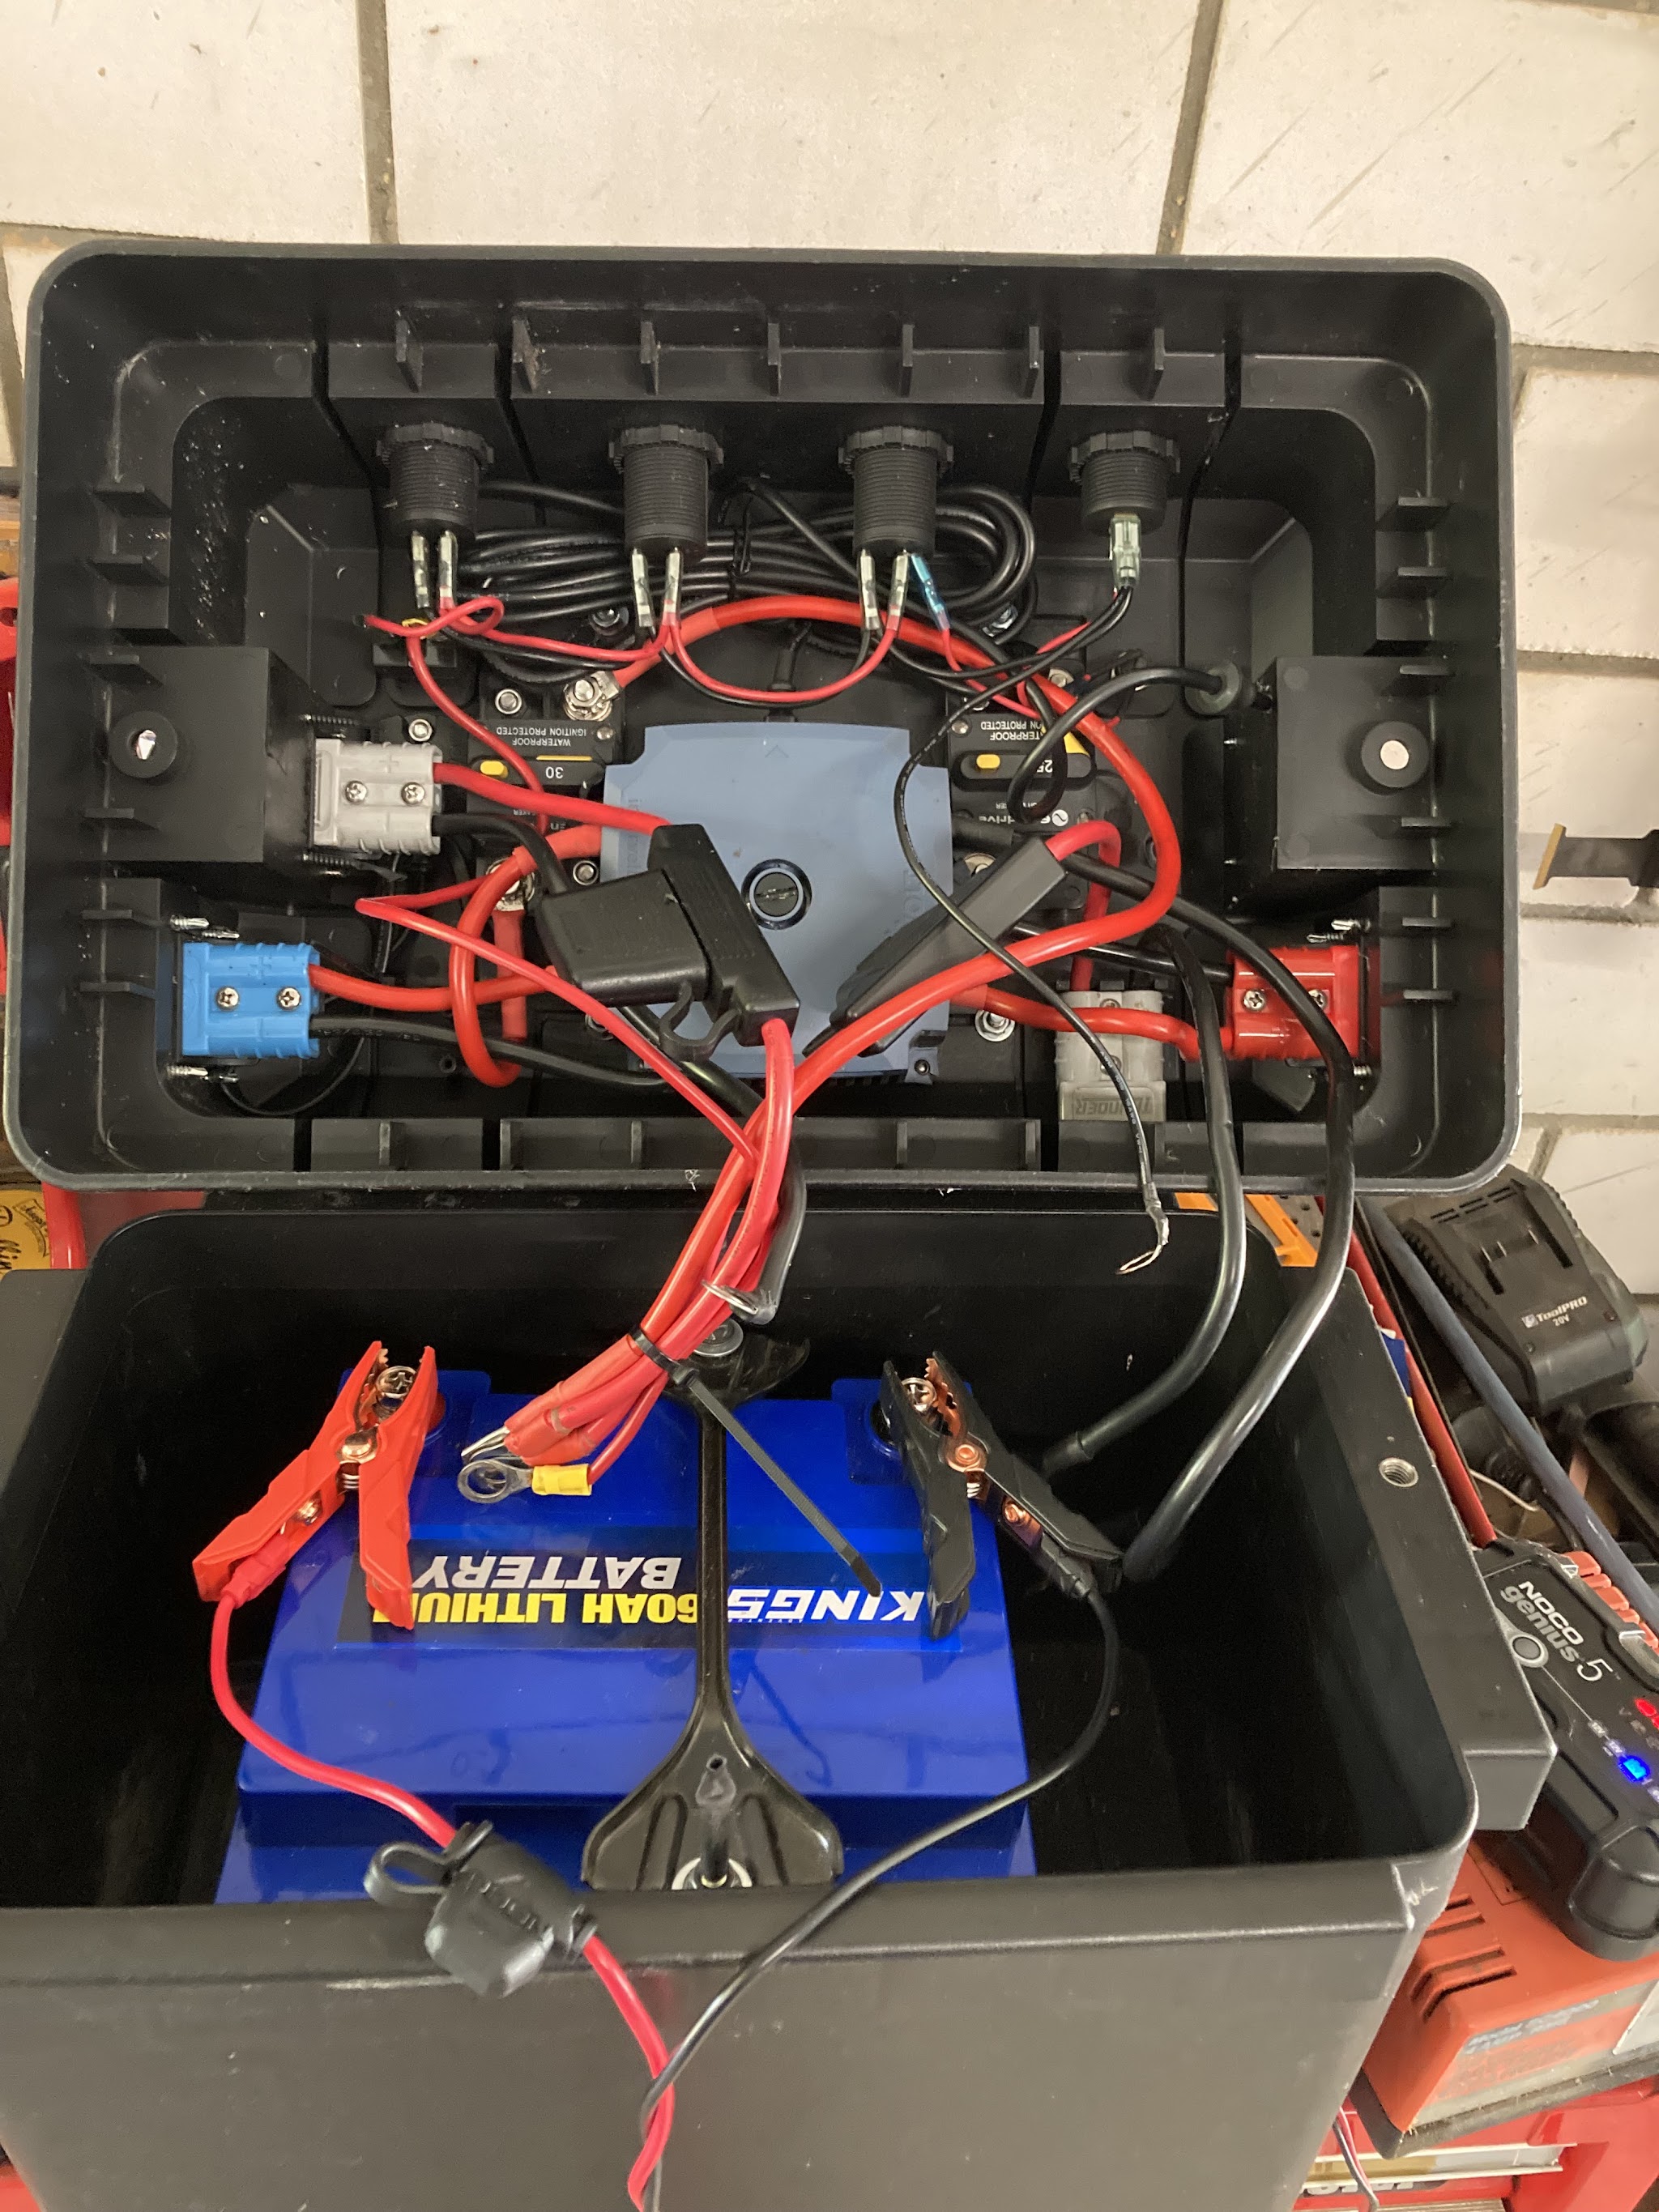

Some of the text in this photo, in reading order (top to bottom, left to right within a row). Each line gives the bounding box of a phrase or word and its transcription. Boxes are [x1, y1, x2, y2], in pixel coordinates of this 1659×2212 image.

[497, 727, 586, 735] IGNITION PROTECTED
[981, 721, 1026, 730] PROTECTED
[990, 731, 1043, 740] TERPROOF
[512, 738, 571, 747] WATERPROOF
[546, 766, 564, 779] 30
[979, 815, 1051, 824] Edrive
[1537, 1296, 1588, 1323] ToolPRO
[1552, 1314, 1570, 1327] 20V
[412, 1556, 682, 1590] BATTERY
[373, 1592, 697, 1625] 60AH LITHIU
[727, 1589, 924, 1622] KINGS
[1518, 1581, 1584, 1646] NOCO
[1500, 1586, 1614, 1681] genius 5
